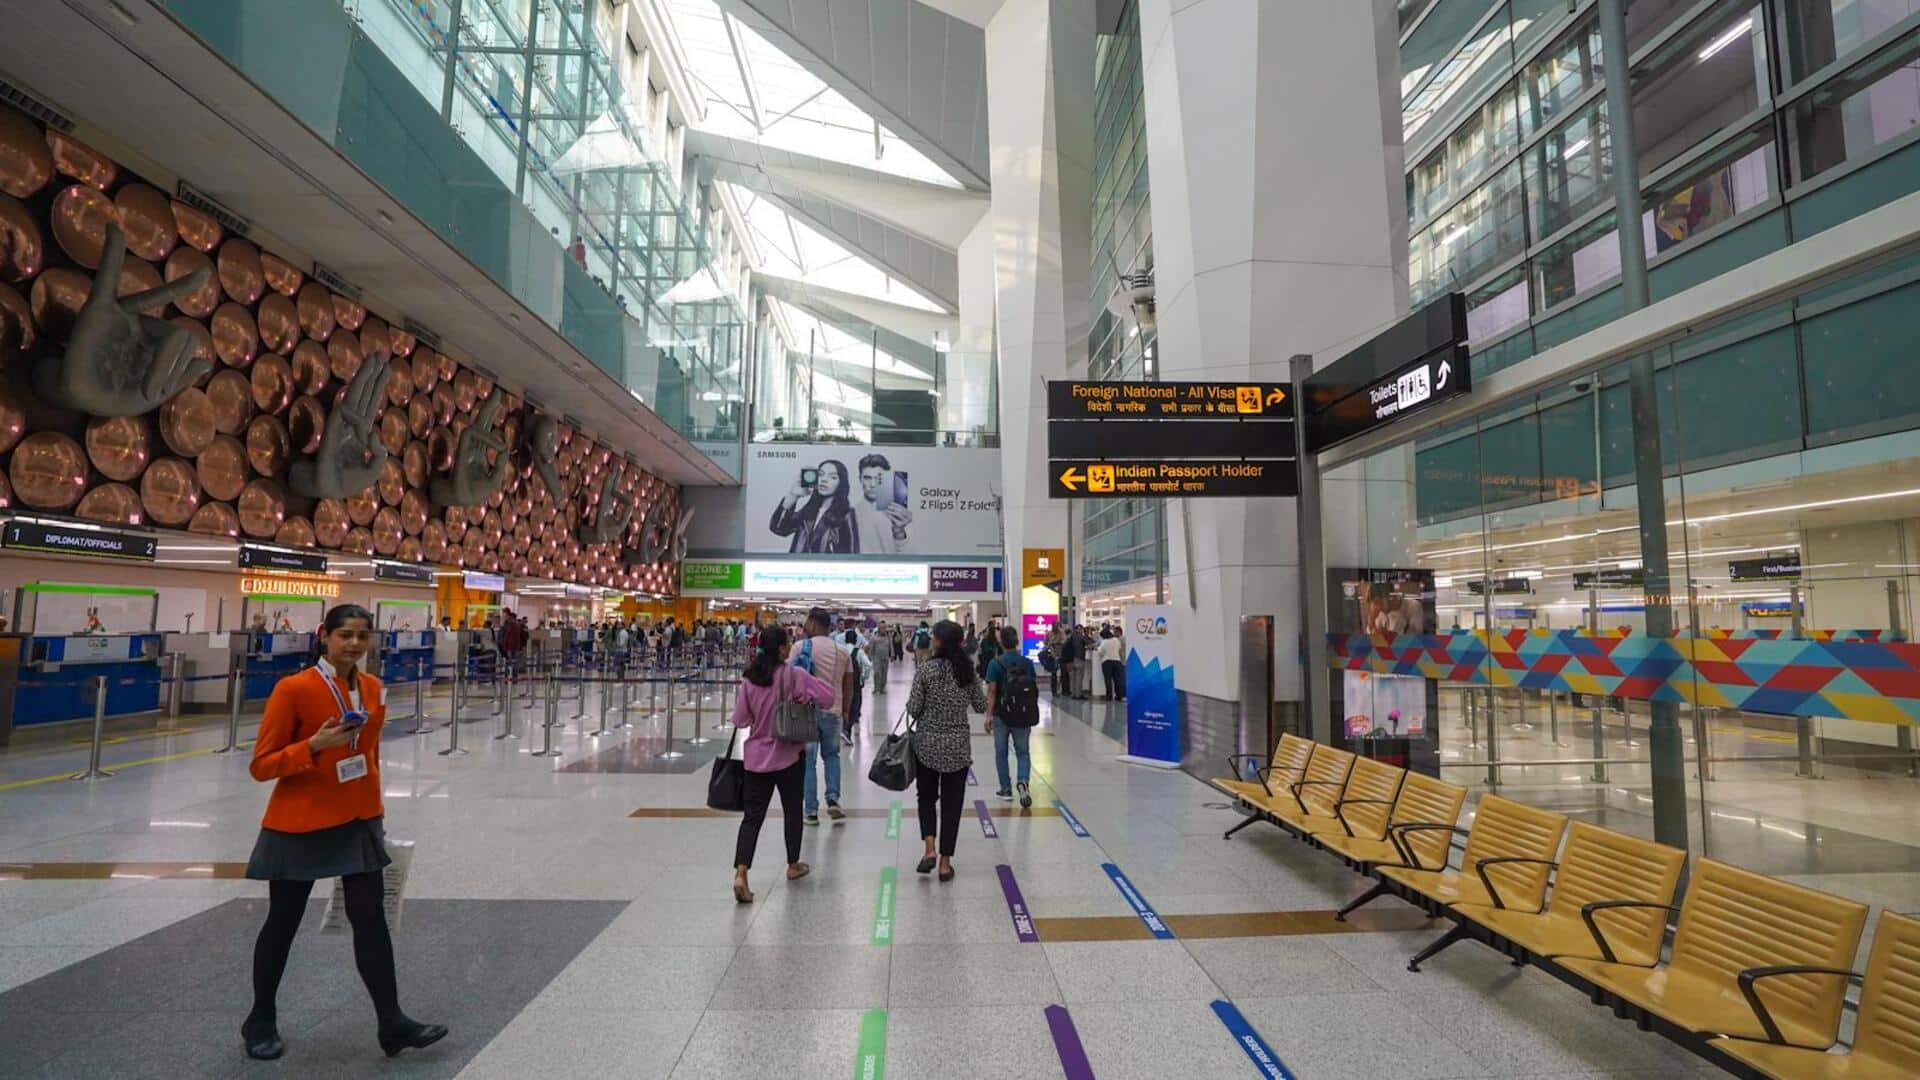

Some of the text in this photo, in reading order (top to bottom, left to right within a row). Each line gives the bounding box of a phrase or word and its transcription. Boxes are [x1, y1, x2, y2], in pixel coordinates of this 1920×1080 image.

[1072, 385, 1119, 399] Foreign
[1124, 386, 1176, 398] National
[1188, 386, 1204, 398] All
[1208, 386, 1236, 399] Visa
[1369, 383, 1397, 405] Toilets
[757, 451, 797, 459] SAMSUNG
[1116, 465, 1264, 479] Indian Passport Holder
[920, 488, 960, 500] Galaxy
[921, 500, 954, 512] Z Flip5
[960, 501, 967, 511] Z
[13, 528, 20, 541] 1
[45, 534, 122, 550] DIPLOMAT/OFFICIALS
[146, 543, 153, 555] 2
[942, 569, 979, 579] ZONE-2
[1729, 566, 1737, 576] 2
[1242, 1035, 1273, 1062] HOLDERS
